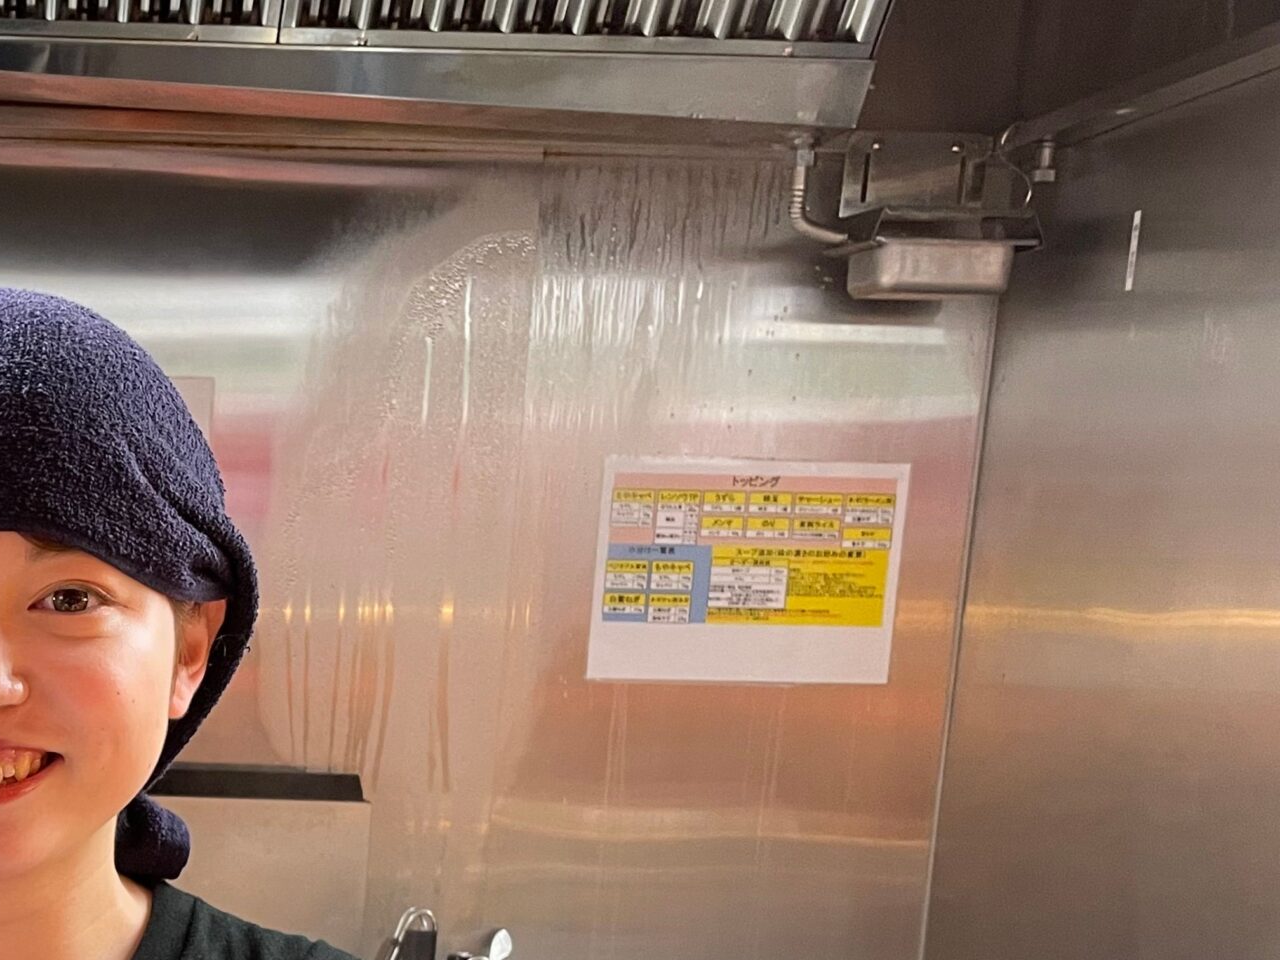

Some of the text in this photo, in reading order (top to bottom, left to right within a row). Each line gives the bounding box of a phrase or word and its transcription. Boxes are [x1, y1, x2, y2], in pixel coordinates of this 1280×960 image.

[733, 475, 781, 488] トッピング
